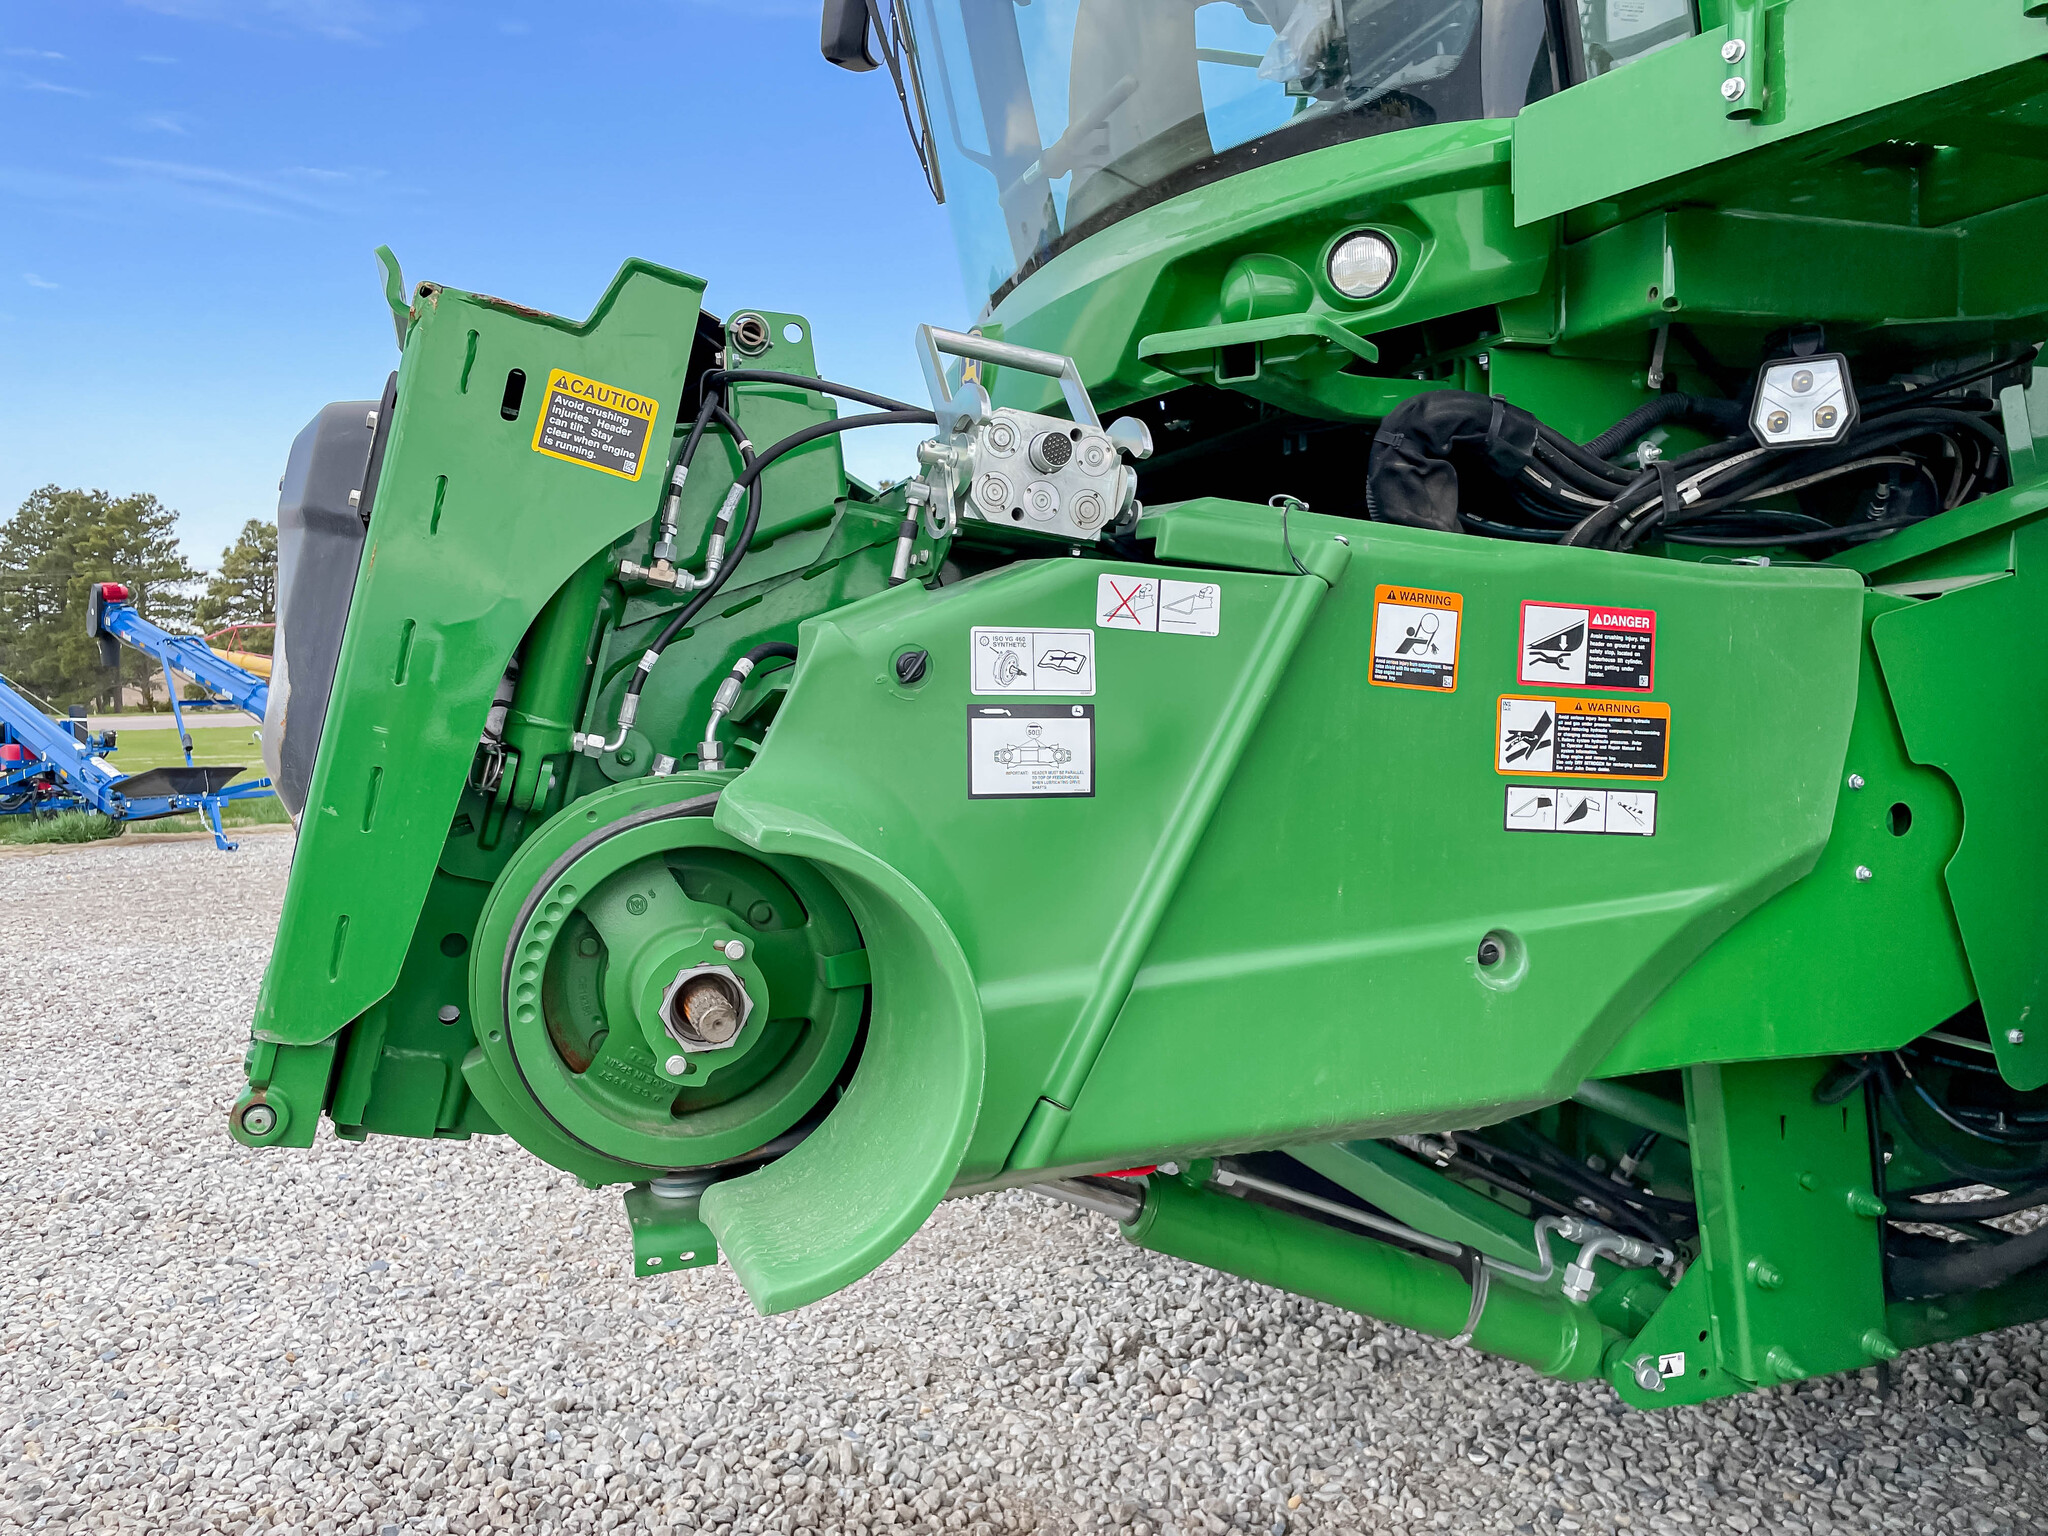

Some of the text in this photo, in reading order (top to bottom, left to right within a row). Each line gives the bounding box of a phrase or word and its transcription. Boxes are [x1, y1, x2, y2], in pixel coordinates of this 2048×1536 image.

[555, 395, 629, 426] Avoid crushing
[571, 380, 652, 416] CAUTION
[550, 417, 613, 442] can tilt. Stay
[552, 405, 632, 436] injuries. Header
[544, 436, 596, 459] is running.
[547, 427, 635, 459] clear when engine
[1400, 591, 1451, 606] WARNING
[1603, 614, 1649, 628] DANGER
[1588, 703, 1640, 714] WARNING
